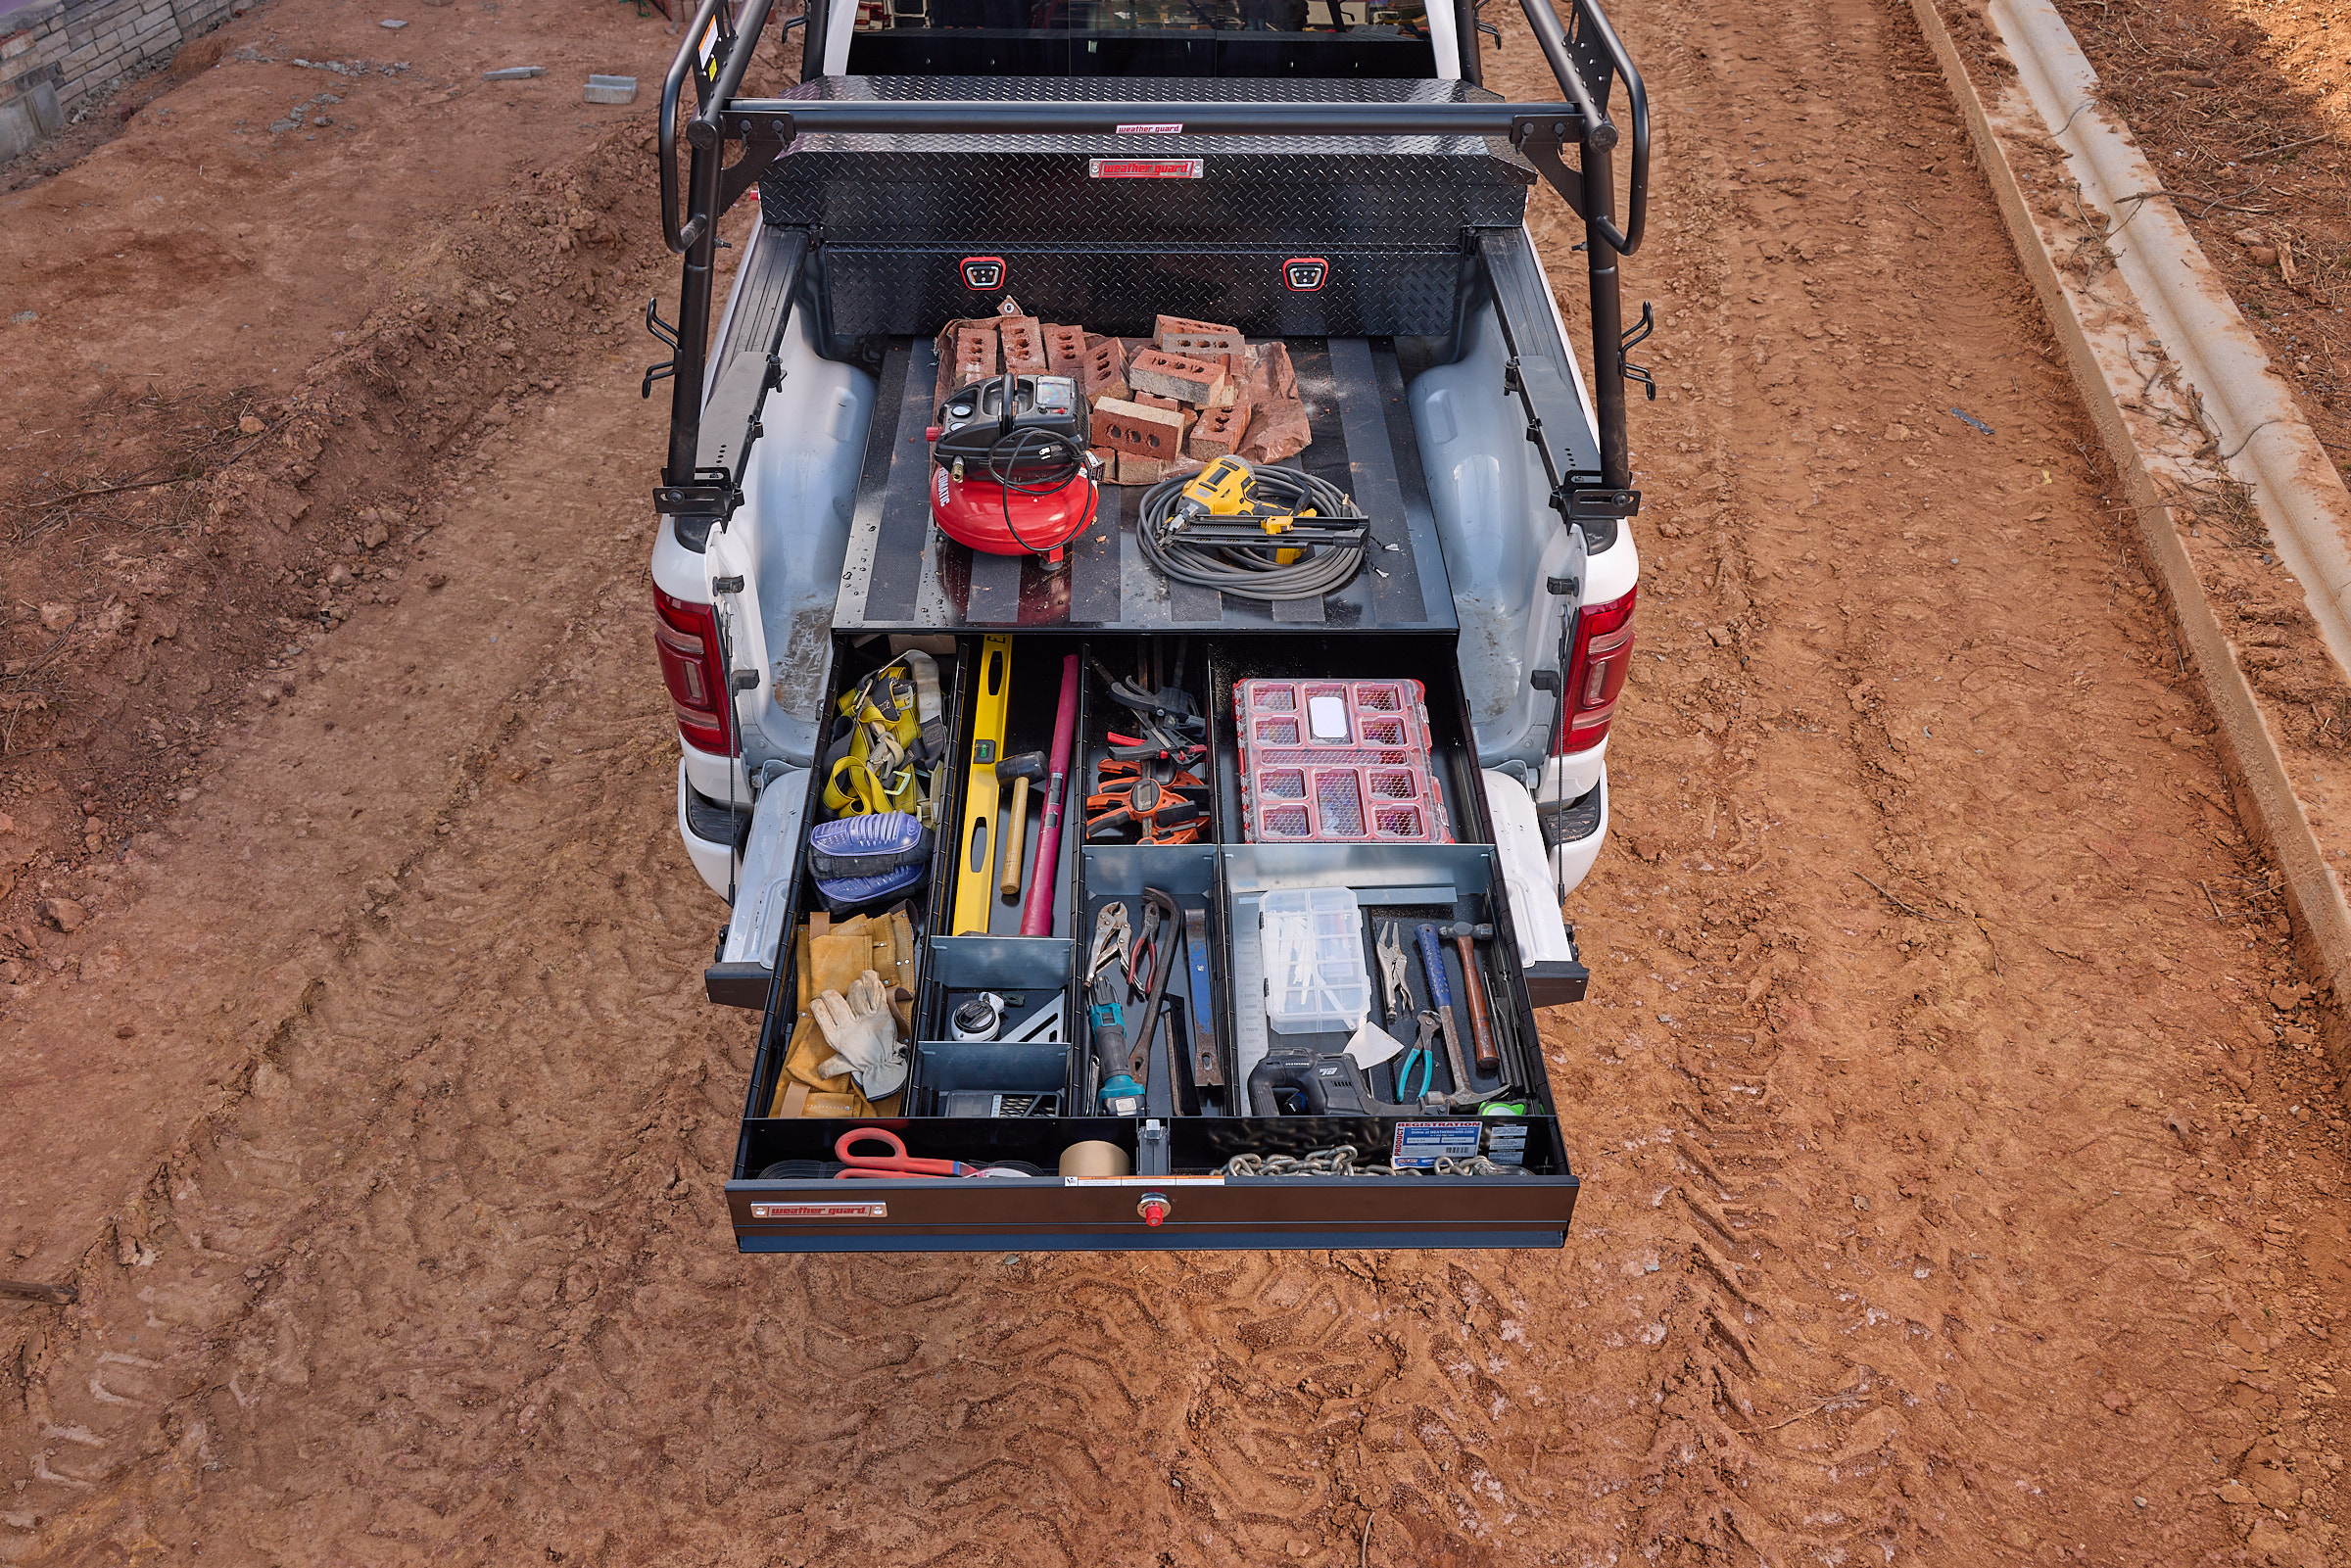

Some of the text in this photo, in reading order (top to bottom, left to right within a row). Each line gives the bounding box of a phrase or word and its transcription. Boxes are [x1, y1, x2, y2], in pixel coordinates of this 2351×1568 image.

[1103, 163, 1188, 174] weather guard
[1394, 1127, 1404, 1156] PRODUCT
